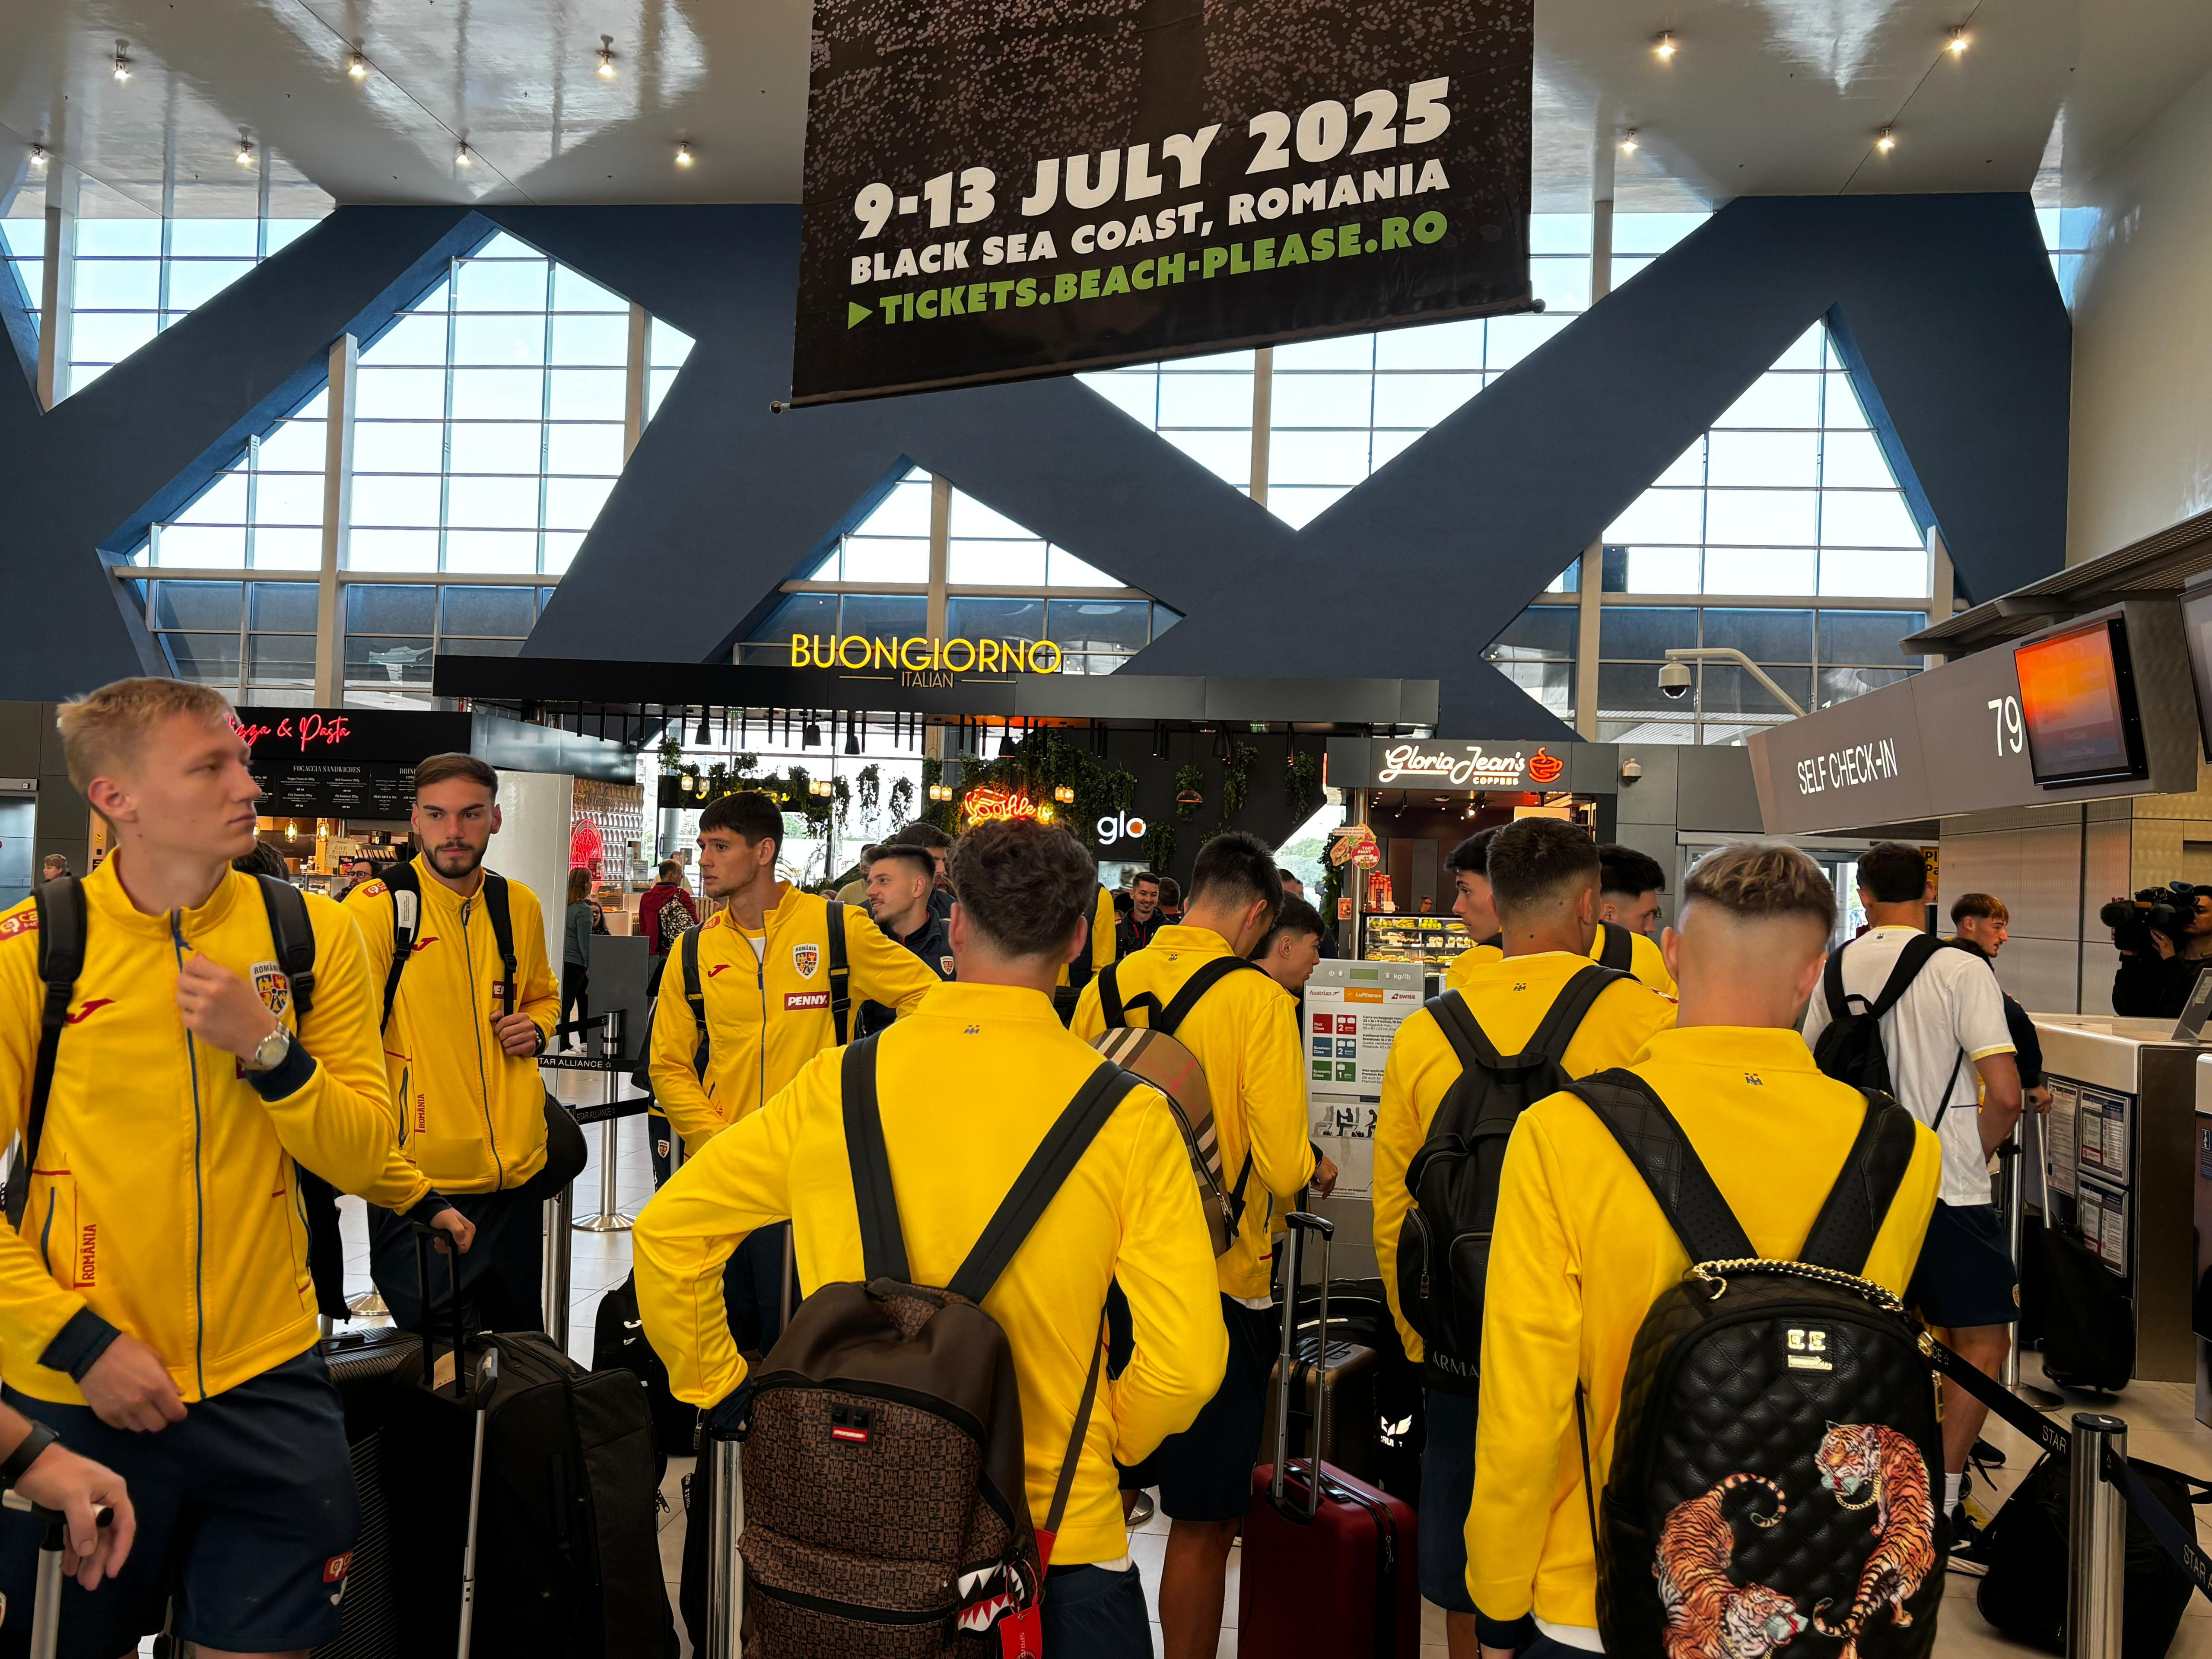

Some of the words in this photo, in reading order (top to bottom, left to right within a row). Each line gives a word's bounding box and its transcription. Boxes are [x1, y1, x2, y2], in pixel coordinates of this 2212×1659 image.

[854, 167, 995, 240] 9-13
[1021, 124, 1224, 217] JULY
[1246, 77, 1452, 175] 2025
[851, 249, 969, 285] BLACK
[982, 233, 1058, 266] SEA
[1071, 201, 1214, 254] COAST,
[1228, 158, 1450, 226] ROMANIA
[880, 210, 1448, 325] TICKETS.BEACH-PLEASE.RO
[791, 633, 1062, 674] BUONGIORNO
[902, 671, 954, 688] ITALIAN
[277, 718, 292, 737] &
[299, 714, 350, 752] Pasta
[1988, 695, 2023, 756] 79
[1379, 744, 1455, 783] Gloria
[1450, 746, 1526, 784] Jean's
[1473, 776, 1519, 785] COFFEES
[1797, 756, 1827, 795] SELF
[1829, 737, 1898, 789] CHECK-IN
[1097, 810, 1146, 845] glo
[558, 1059, 603, 1068] ALLIANCE
[577, 1111, 589, 1122] STAR
[590, 1107, 612, 1118] ALLIANCE
[80, 1223, 97, 1280] ROMÂNIA
[1433, 1351, 1480, 1378] ARMA
[2042, 1425, 2066, 1454] STAR
[2183, 1544, 2206, 1584] STAR
